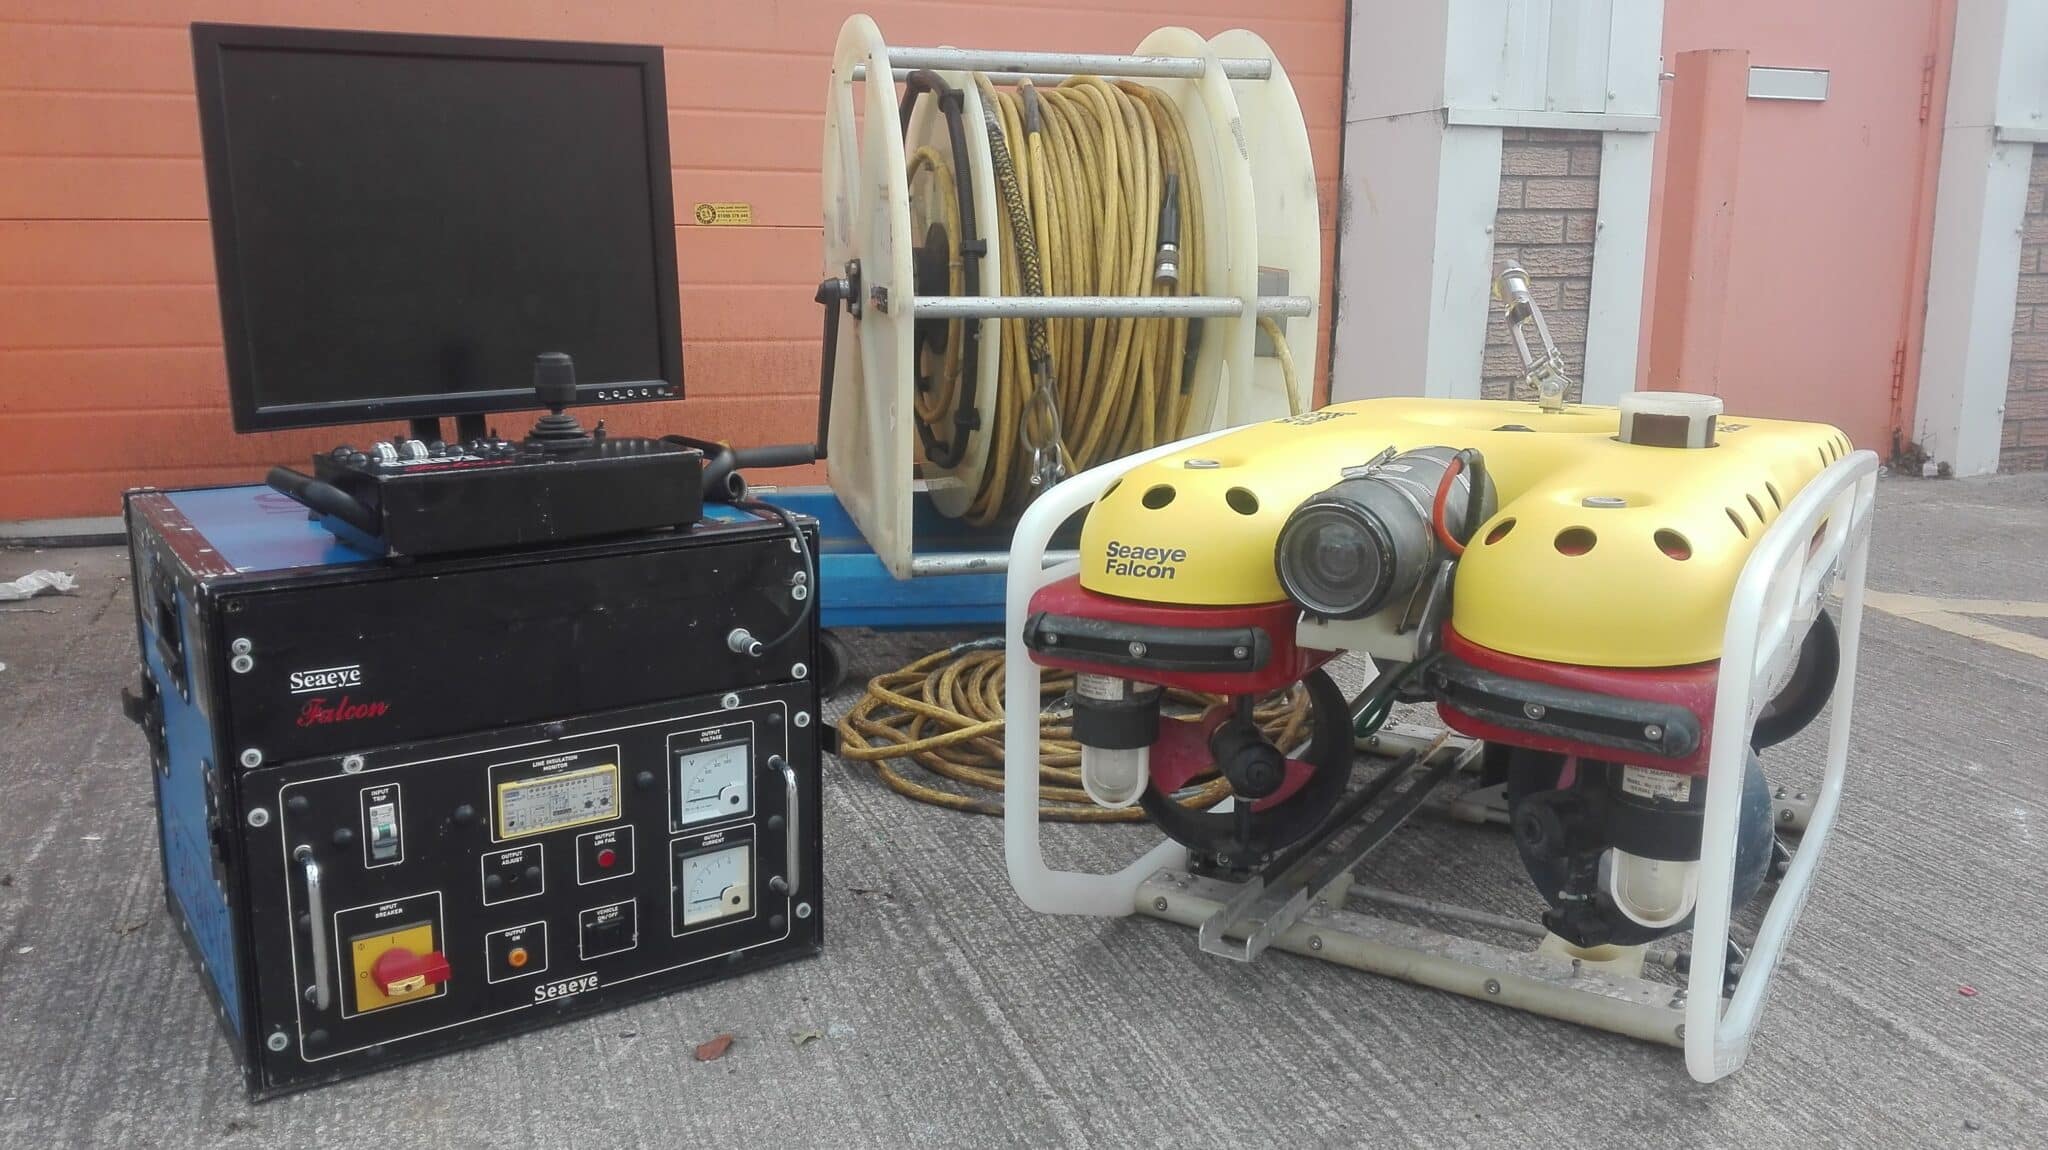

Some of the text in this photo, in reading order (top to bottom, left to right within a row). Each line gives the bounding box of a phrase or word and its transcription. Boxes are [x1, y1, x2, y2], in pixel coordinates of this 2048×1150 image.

[1106, 541, 1186, 565] Seaeye
[1105, 559, 1176, 580] Falcon
[290, 667, 361, 689] Seaeye
[296, 696, 390, 727] Falcon
[701, 729, 720, 737] OUTPUT
[700, 734, 722, 743] VOLTAGE
[371, 788, 389, 796] INPUT
[595, 831, 615, 840] OUTPUT
[703, 832, 723, 841] OUTPUT
[702, 837, 725, 847] CURRENT
[501, 850, 523, 859] OUTPUT
[505, 927, 526, 937] OUTPUT
[534, 975, 598, 1001] Seaeye
